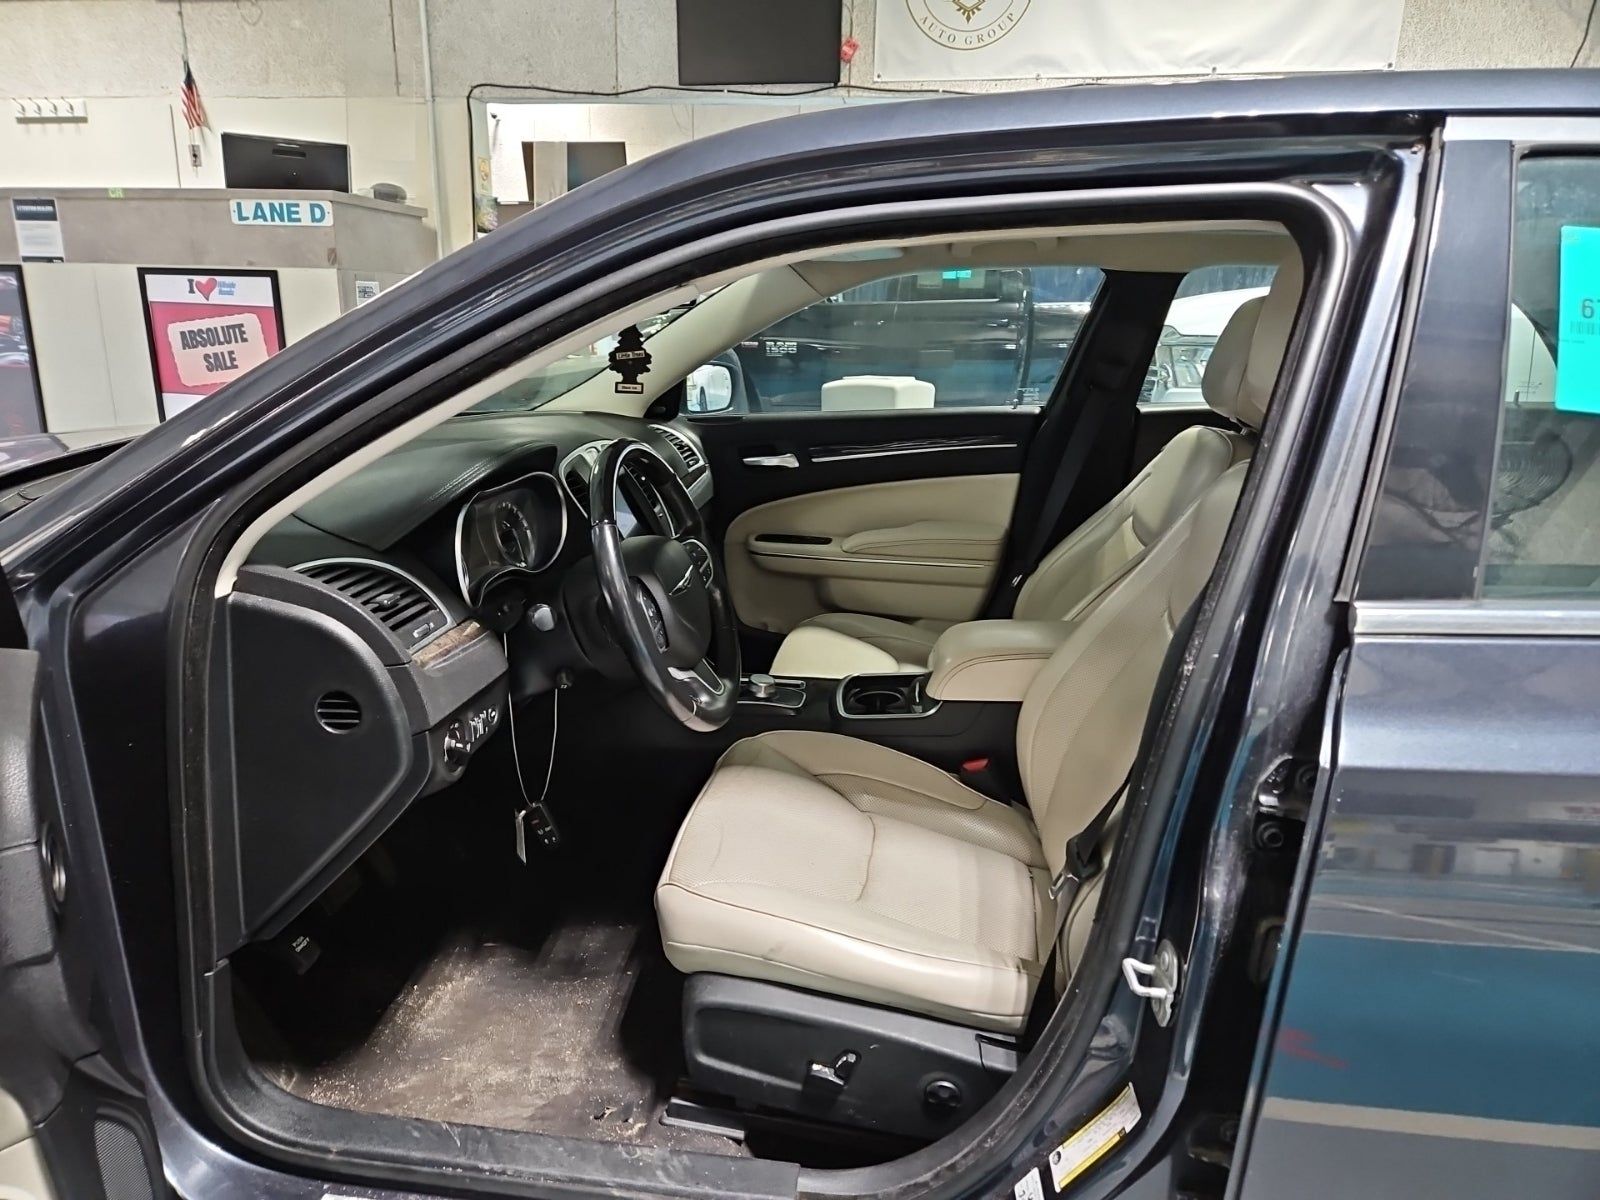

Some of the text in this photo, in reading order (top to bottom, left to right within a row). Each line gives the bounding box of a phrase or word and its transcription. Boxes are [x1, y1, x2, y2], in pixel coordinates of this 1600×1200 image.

[920, 12, 1016, 46] AUTO GROUP
[235, 201, 326, 224] LANE D
[187, 278, 196, 294] I
[1581, 298, 1600, 319] 6
[179, 322, 248, 350] ABSOLUTE
[203, 350, 239, 373] SALE
